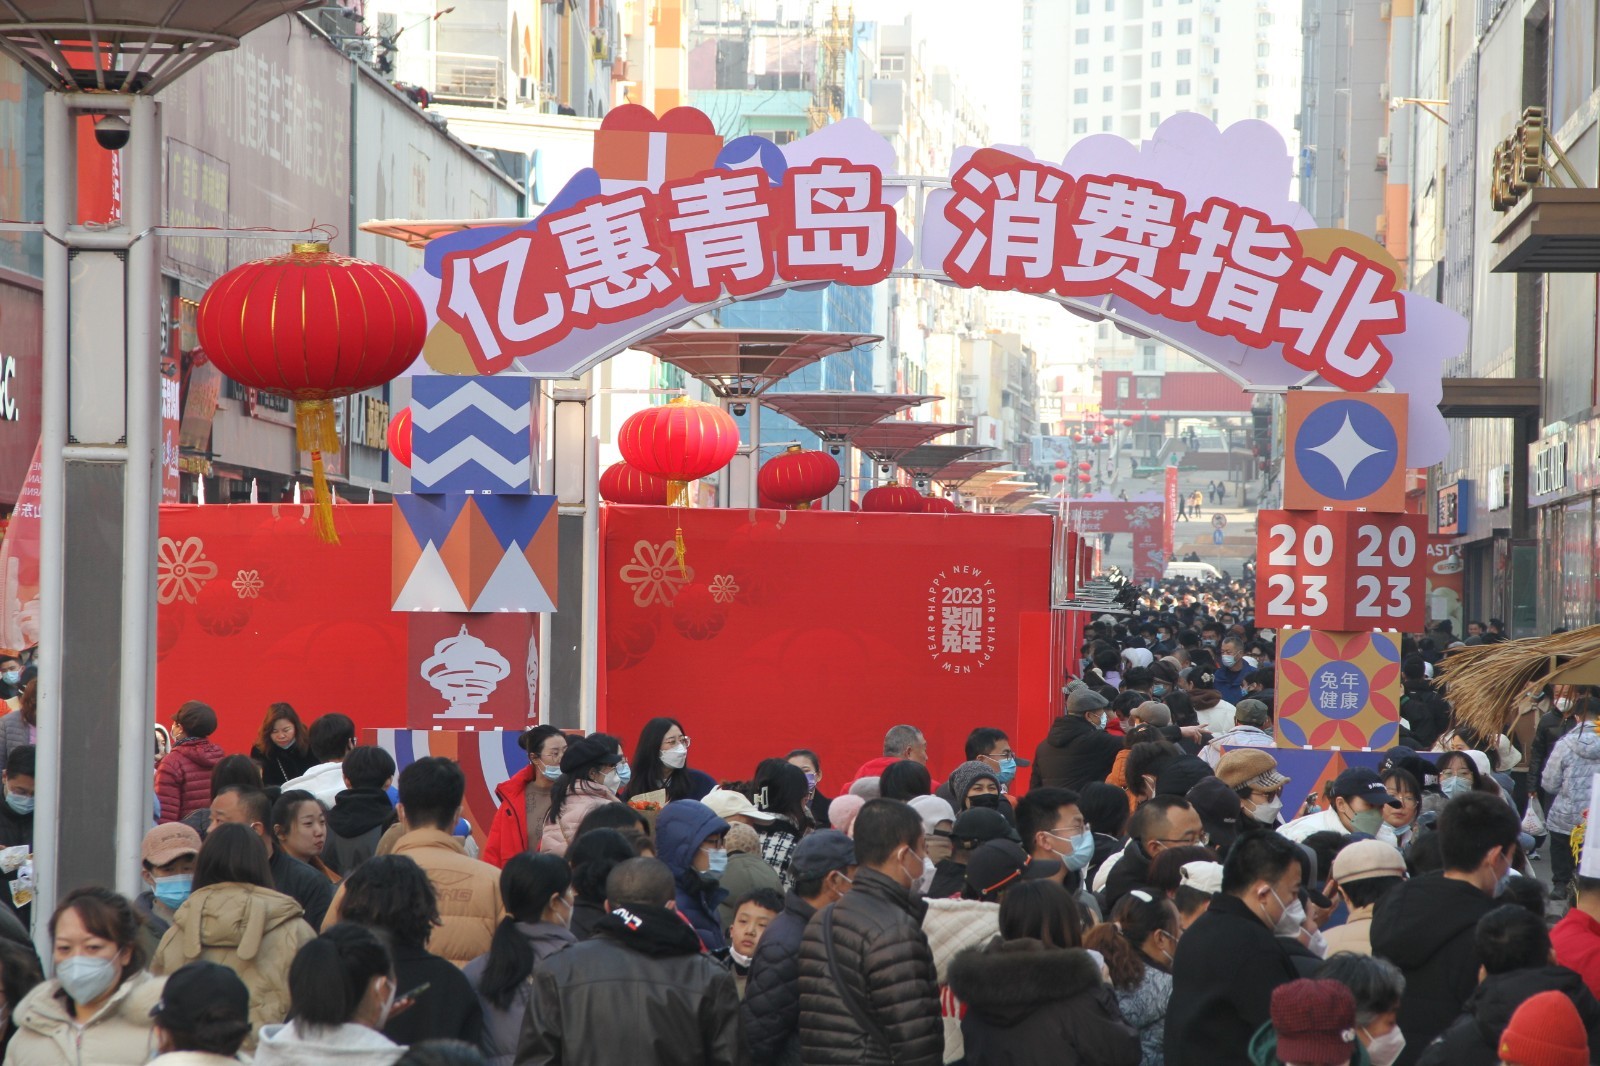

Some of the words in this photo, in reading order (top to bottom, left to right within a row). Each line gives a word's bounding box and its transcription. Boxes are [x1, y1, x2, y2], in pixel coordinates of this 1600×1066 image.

[448, 164, 886, 361] 亿惠青岛
[953, 167, 1399, 378] 消费指北
[1269, 524, 1334, 567] 20
[1357, 524, 1416, 567] 20
[928, 571, 946, 612] HAPPY
[953, 565, 982, 577] NEW
[984, 579, 995, 613] YEAR
[942, 587, 983, 604] 2023
[1267, 574, 1329, 617] 23
[1355, 575, 1412, 618] 23
[928, 626, 940, 660] YEAR
[978, 626, 996, 668] HAPPY
[942, 661, 971, 673] NEW
[1319, 671, 1360, 689] 兔年
[1319, 690, 1359, 710] 健康
